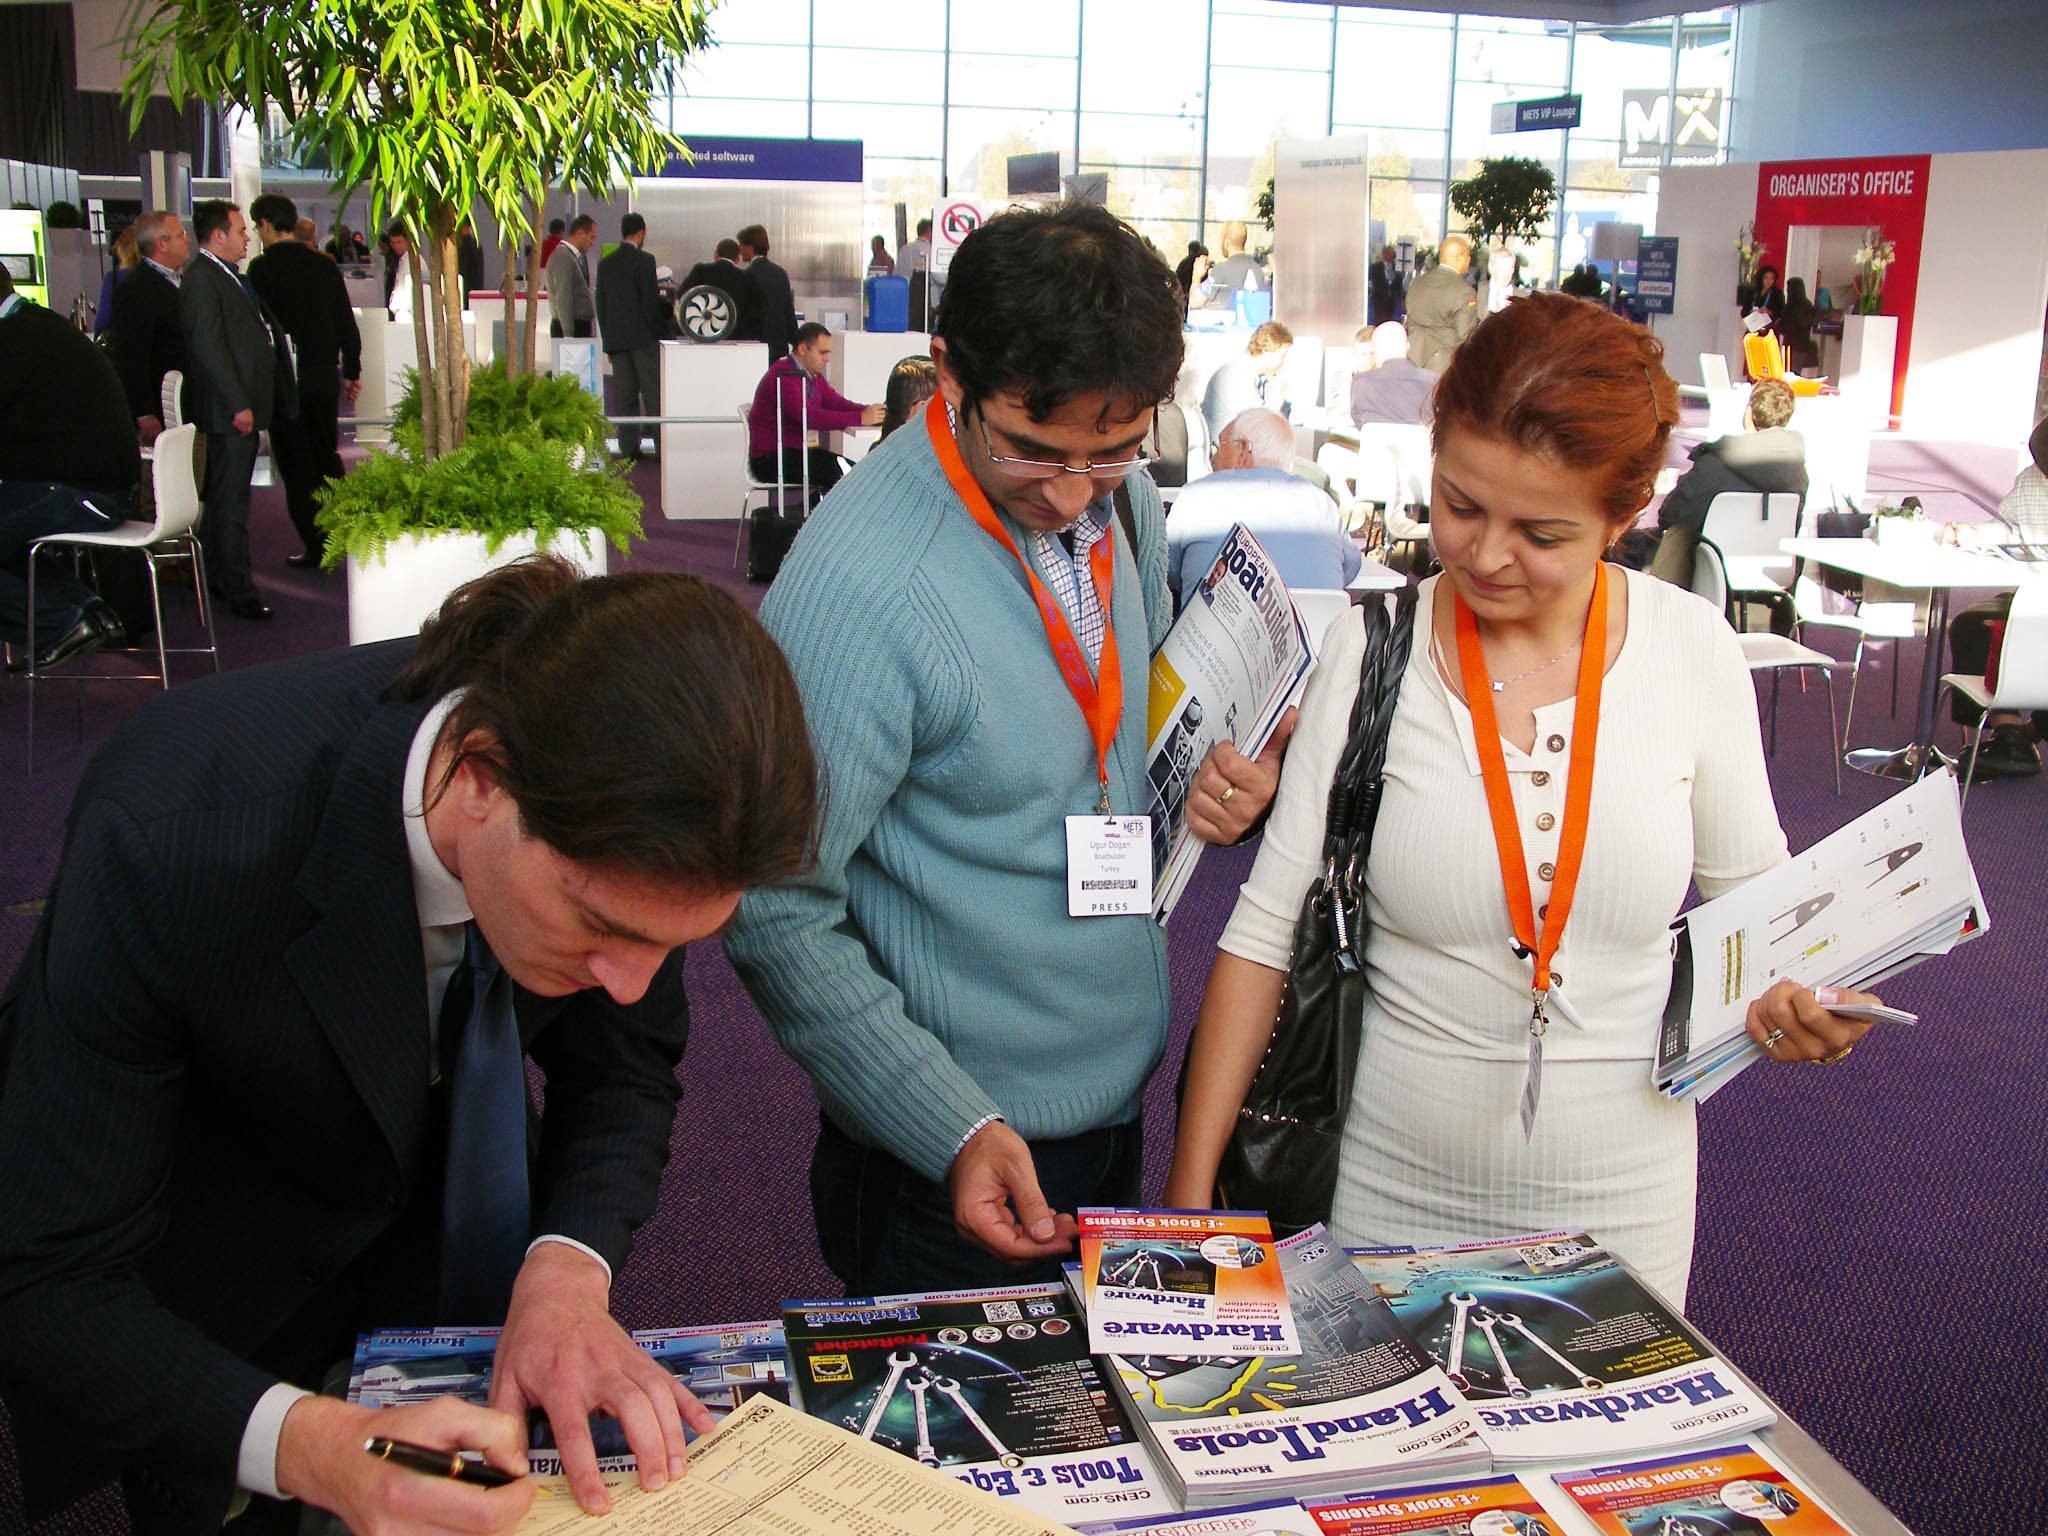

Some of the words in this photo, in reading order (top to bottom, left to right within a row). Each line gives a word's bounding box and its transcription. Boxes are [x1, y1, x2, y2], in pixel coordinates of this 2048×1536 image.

[1523, 108, 1540, 121] METS
[1541, 107, 1552, 119] VIP
[1552, 107, 1577, 119] Lounge
[712, 151, 755, 163] software
[1770, 172, 1860, 197] ORGANISER'S
[1863, 170, 1914, 194] OFFICE
[1237, 533, 1269, 578] EUROPEAN
[1123, 822, 1144, 834] METS
[1109, 841, 1130, 850] Dogan
[1092, 903, 1128, 912] PRESS
[1084, 1217, 1156, 1227] Systems
[1159, 1217, 1226, 1228] +E-Book
[1459, 1232, 1567, 1250] Hardware.cens.com
[924, 1286, 1047, 1301] Hardware.cens.com
[1103, 1290, 1206, 1309] Hardware
[805, 1305, 920, 1325] Hardware
[676, 1323, 768, 1336] Watercraft.cens.com
[1103, 1322, 1285, 1341] Hardware
[378, 1337, 466, 1347] Hardware
[813, 1332, 928, 1351] ProRatchet
[1645, 1336, 1682, 1349] Fasteners
[1623, 1350, 1658, 1362] Materials
[1632, 1361, 1670, 1373] Equipment
[1638, 1371, 1691, 1389] professional
[1478, 1372, 1734, 1428] Hardware
[1508, 1399, 1549, 1407] hardware
[1565, 1391, 1604, 1400] reference
[729, 1416, 748, 1431] CHINA
[1672, 1404, 1749, 1432] CENS.com
[703, 1427, 732, 1450] ECONOMIC
[1398, 1420, 1470, 1455] CENS.com
[1021, 1468, 1047, 1486] &
[1051, 1456, 1143, 1488] Tools
[1195, 1465, 1273, 1477] Hardware
[1651, 1464, 1724, 1484] +E-Book
[1572, 1477, 1652, 1498] Systems
[1064, 1490, 1150, 1506] CENS.com
[1403, 1493, 1481, 1515] +E-Book
[1318, 1503, 1401, 1523] Systems
